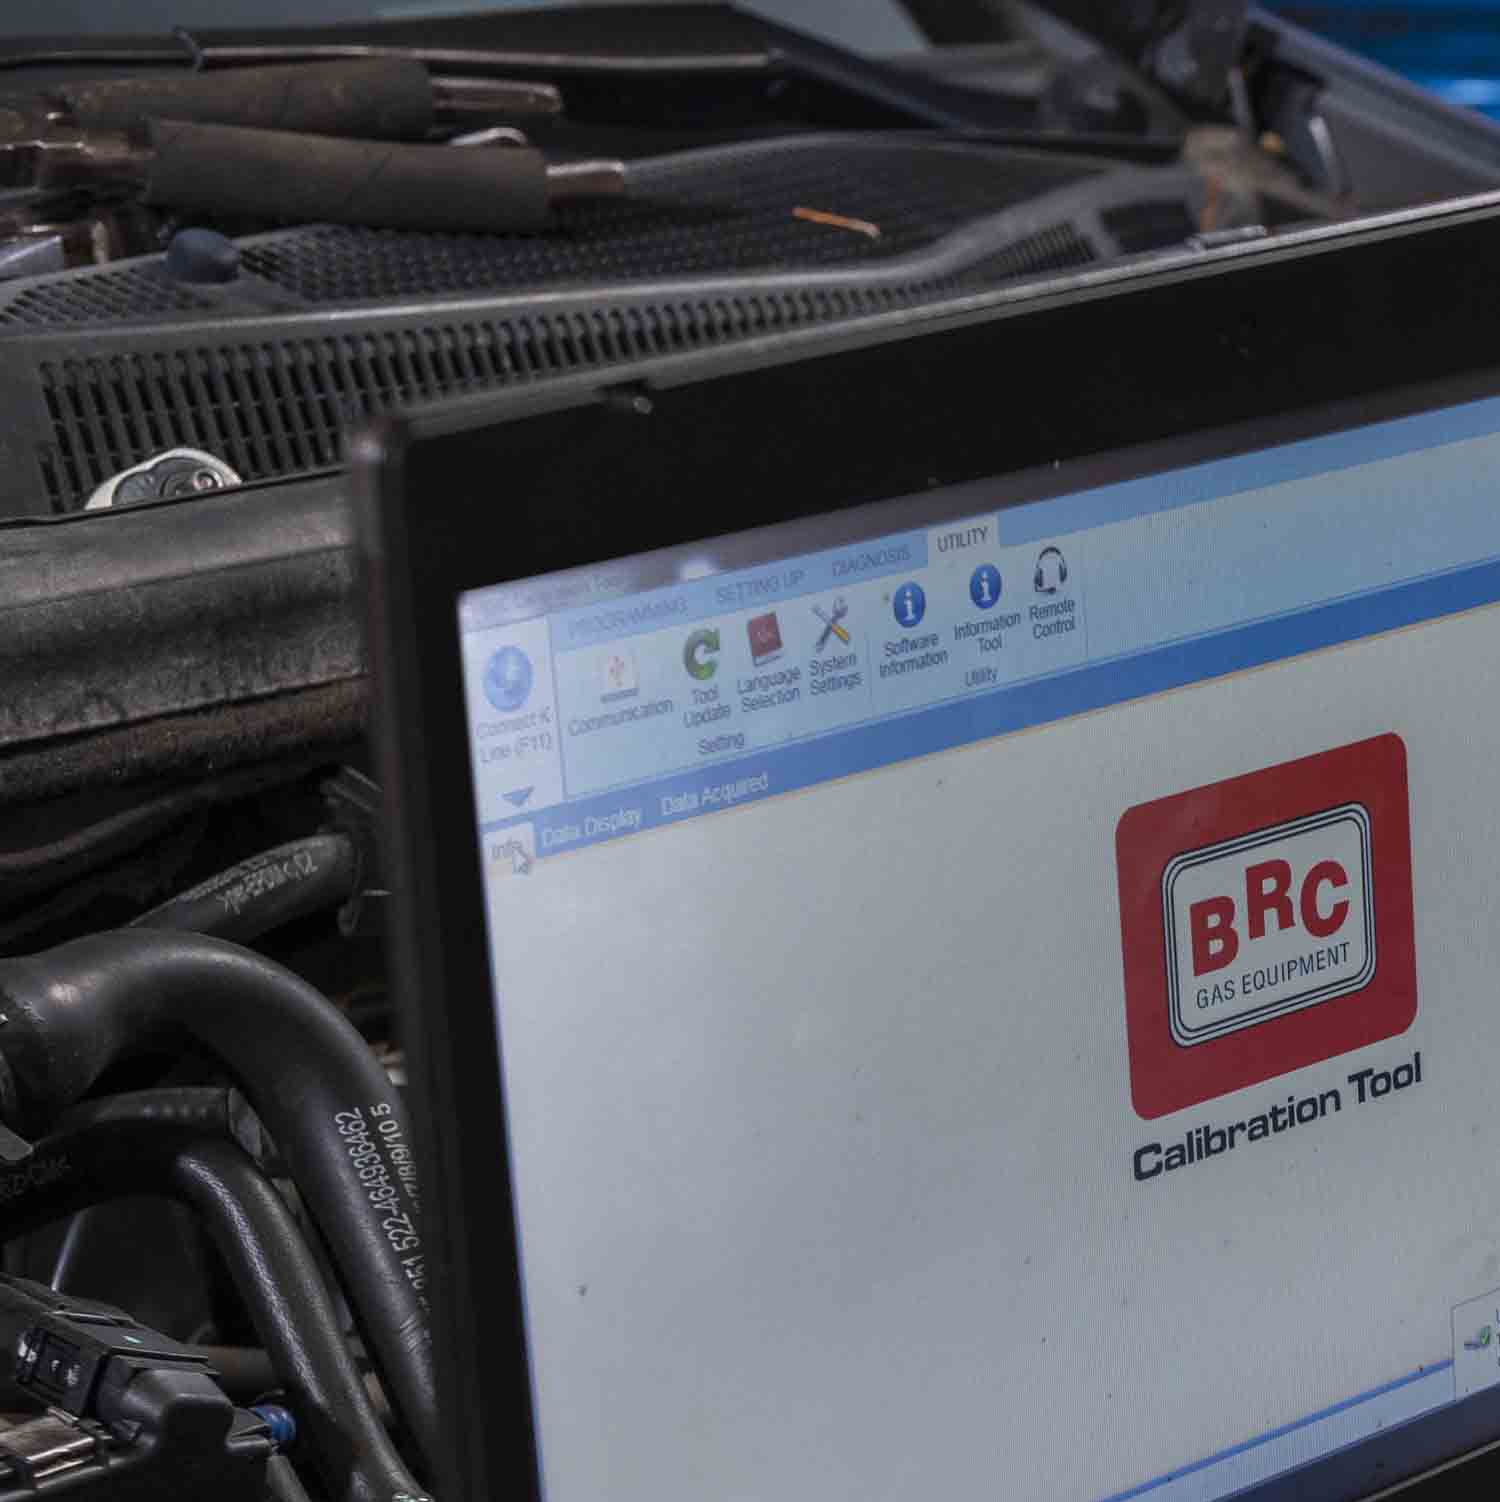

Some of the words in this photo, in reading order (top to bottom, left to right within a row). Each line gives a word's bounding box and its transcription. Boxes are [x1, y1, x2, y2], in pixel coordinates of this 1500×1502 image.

[936, 526, 989, 553] UTILITY
[832, 545, 911, 577] DIAGNOSIS
[716, 573, 780, 604] SETTING
[783, 569, 805, 592] UP
[1029, 597, 1076, 622] Remote
[954, 611, 1021, 641] Information
[1032, 616, 1076, 641] Control
[884, 632, 939, 659] Software
[978, 634, 1002, 653] Tool
[809, 652, 858, 680] System
[879, 649, 949, 679] Information
[965, 667, 998, 689] Utility
[737, 666, 801, 696] Language
[810, 672, 864, 697] Settings
[691, 686, 719, 705] Tool
[741, 687, 801, 713] Selection
[568, 698, 674, 738] Communication
[683, 703, 731, 730] Update
[698, 732, 745, 756] Setting
[661, 792, 698, 817] Data
[702, 772, 769, 804] Acquired
[584, 808, 641, 838] Display
[1189, 859, 1351, 976] BRC
[1195, 980, 1236, 1010] GAS
[1242, 942, 1351, 995] EQUIPMENT
[1132, 1083, 1342, 1182] Calibration
[1347, 1052, 1423, 1104] Tool
